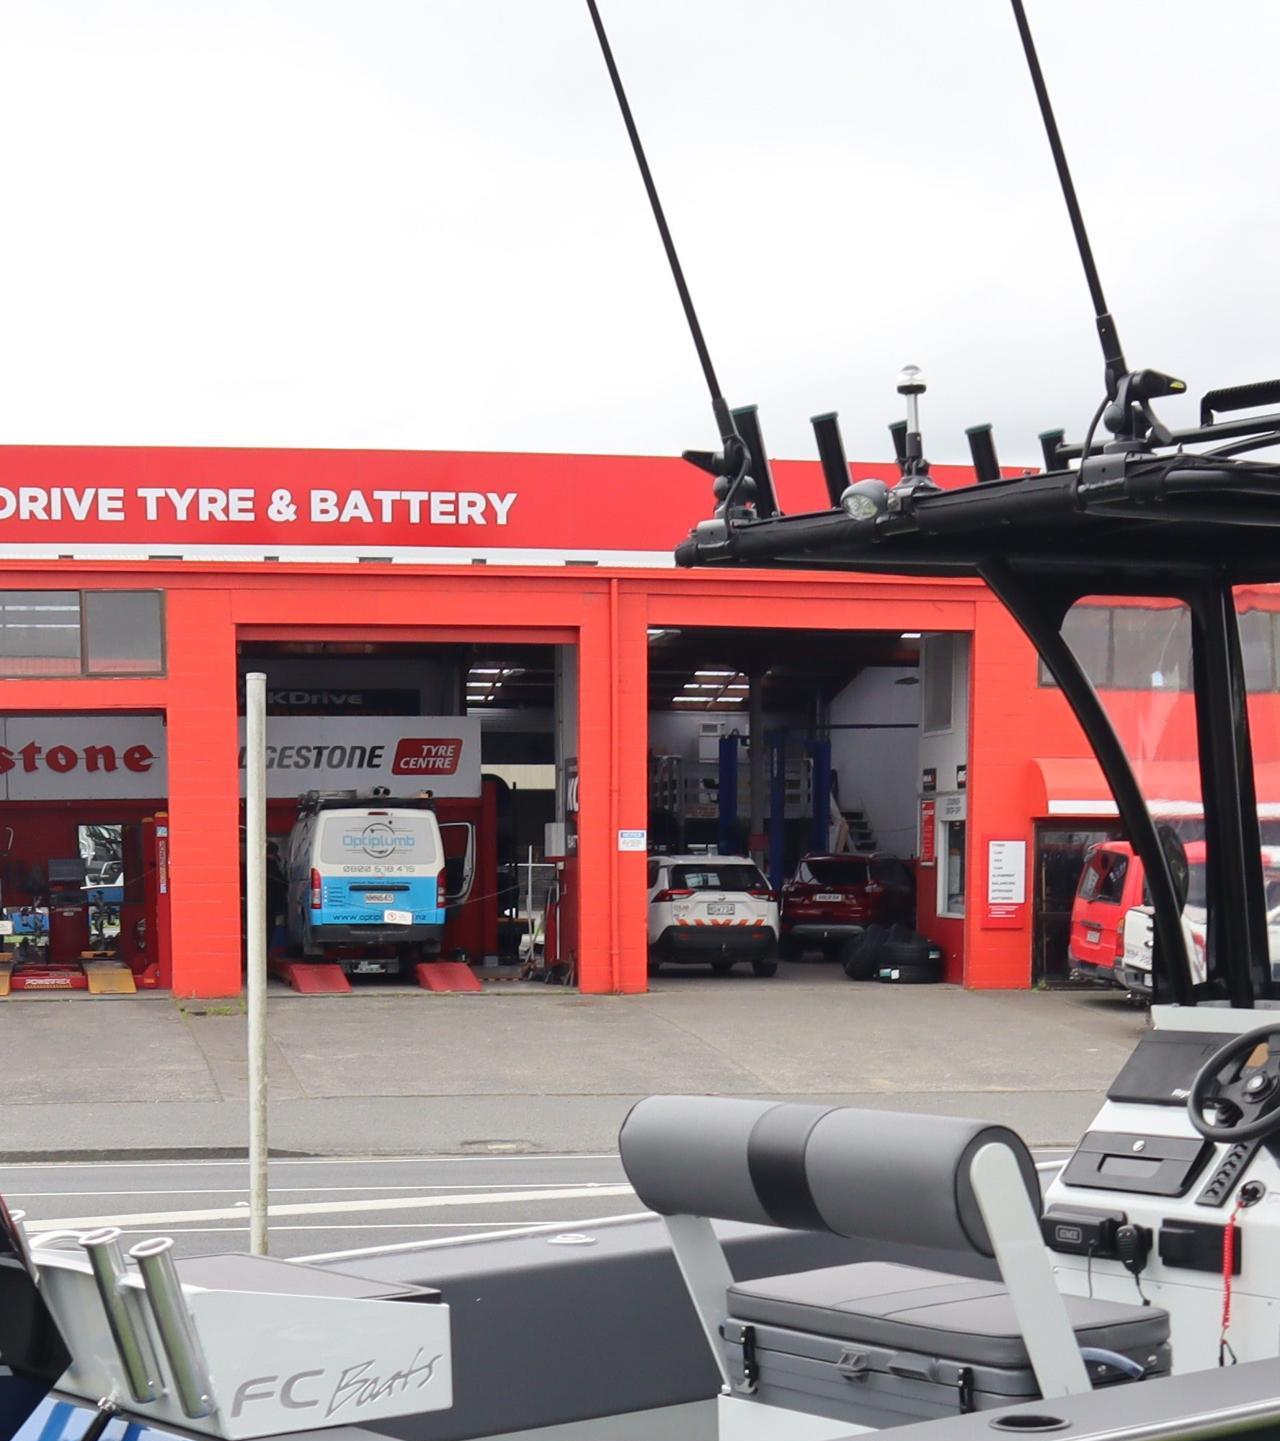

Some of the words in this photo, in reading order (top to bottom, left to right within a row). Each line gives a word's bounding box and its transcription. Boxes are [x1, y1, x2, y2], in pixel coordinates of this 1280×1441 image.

[137, 487, 256, 522] TYRE
[267, 489, 299, 524] &
[311, 491, 518, 526] BATTERY
[422, 744, 457, 757] TYRE
[399, 757, 454, 769] CENTRE
[342, 835, 416, 848] Optiplumb
[343, 865, 372, 873] 0800
[230, 1368, 326, 1418] FC
